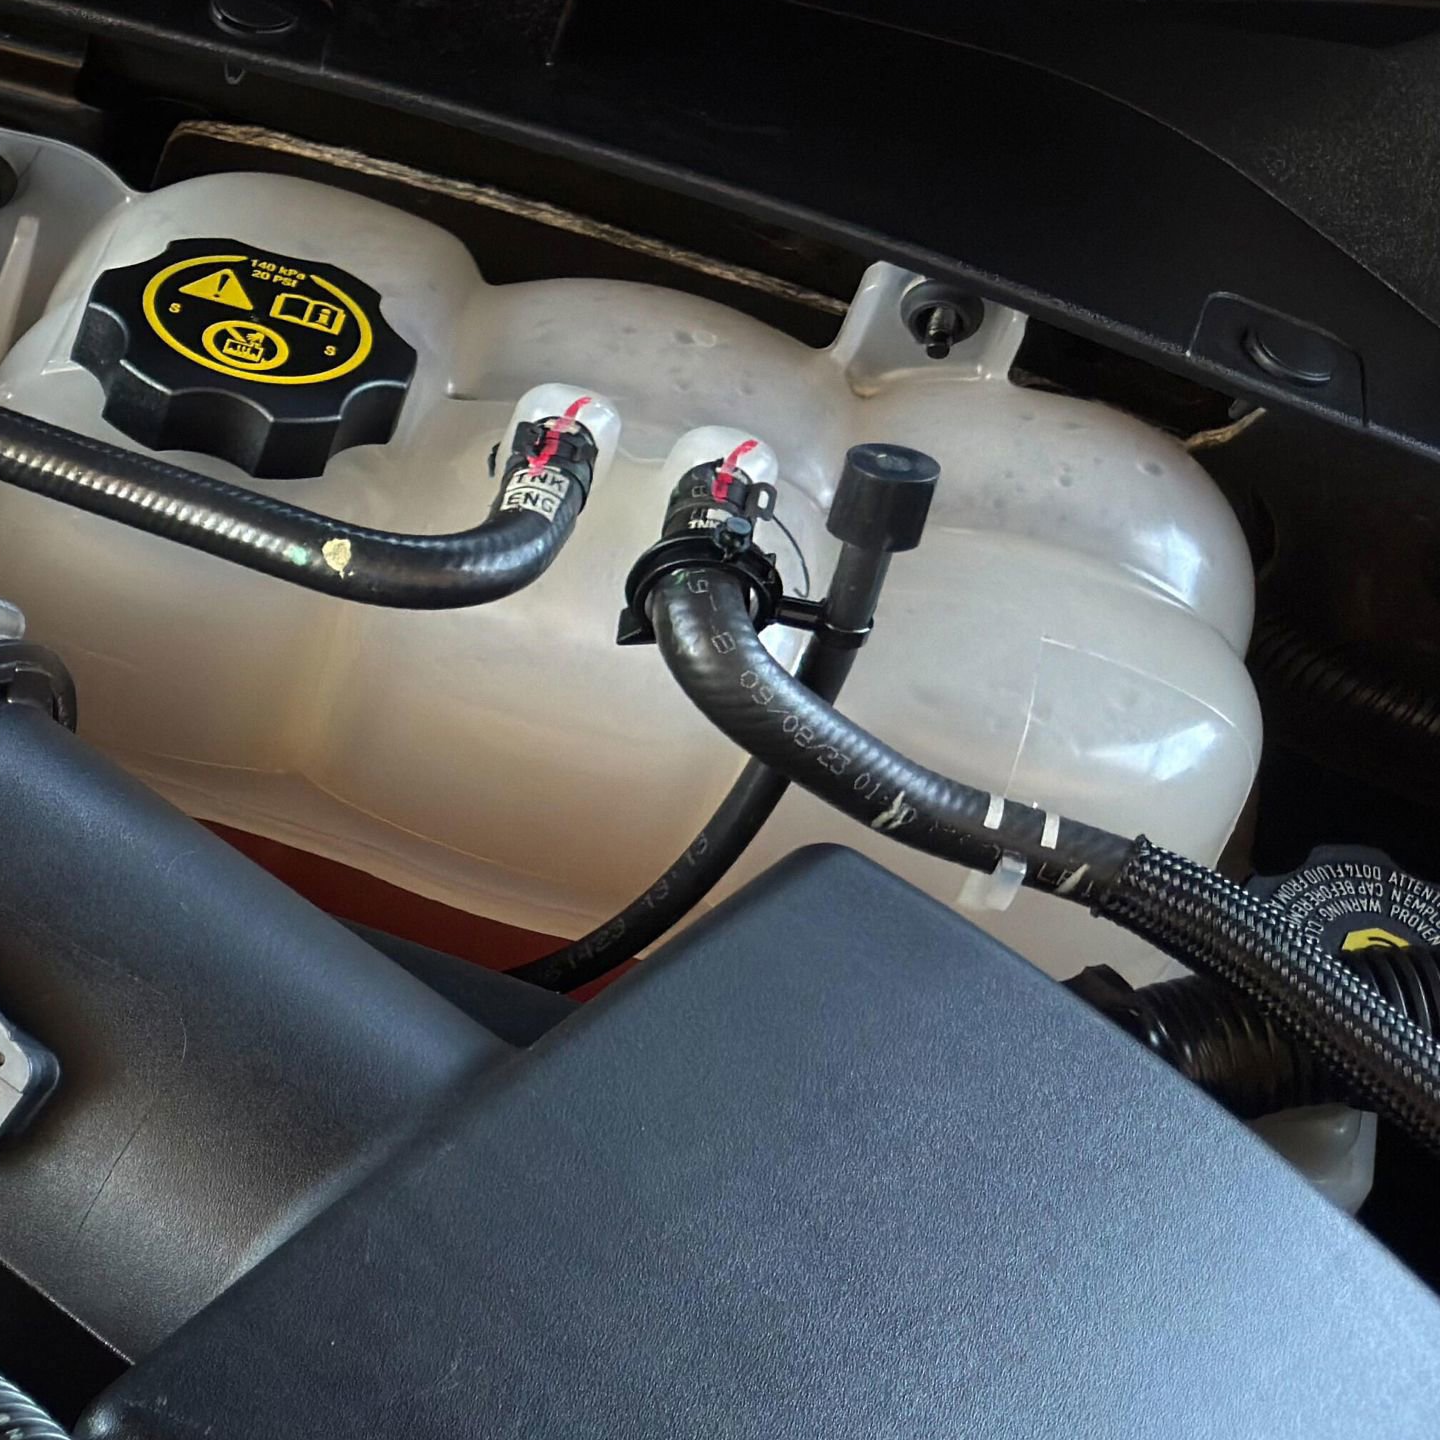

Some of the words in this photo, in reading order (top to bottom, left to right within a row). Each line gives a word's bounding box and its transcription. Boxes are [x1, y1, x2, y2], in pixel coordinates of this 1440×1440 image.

[250, 259, 277, 273] 140
[278, 265, 307, 280] kPa
[251, 269, 270, 281] 20
[506, 491, 558, 513] ENG
[1303, 864, 1345, 885] FLUID
[1273, 874, 1309, 905] FROM
[1304, 880, 1356, 906] BEFORE
[1358, 881, 1384, 897] CAP
[1388, 871, 1440, 907] ATTENT
